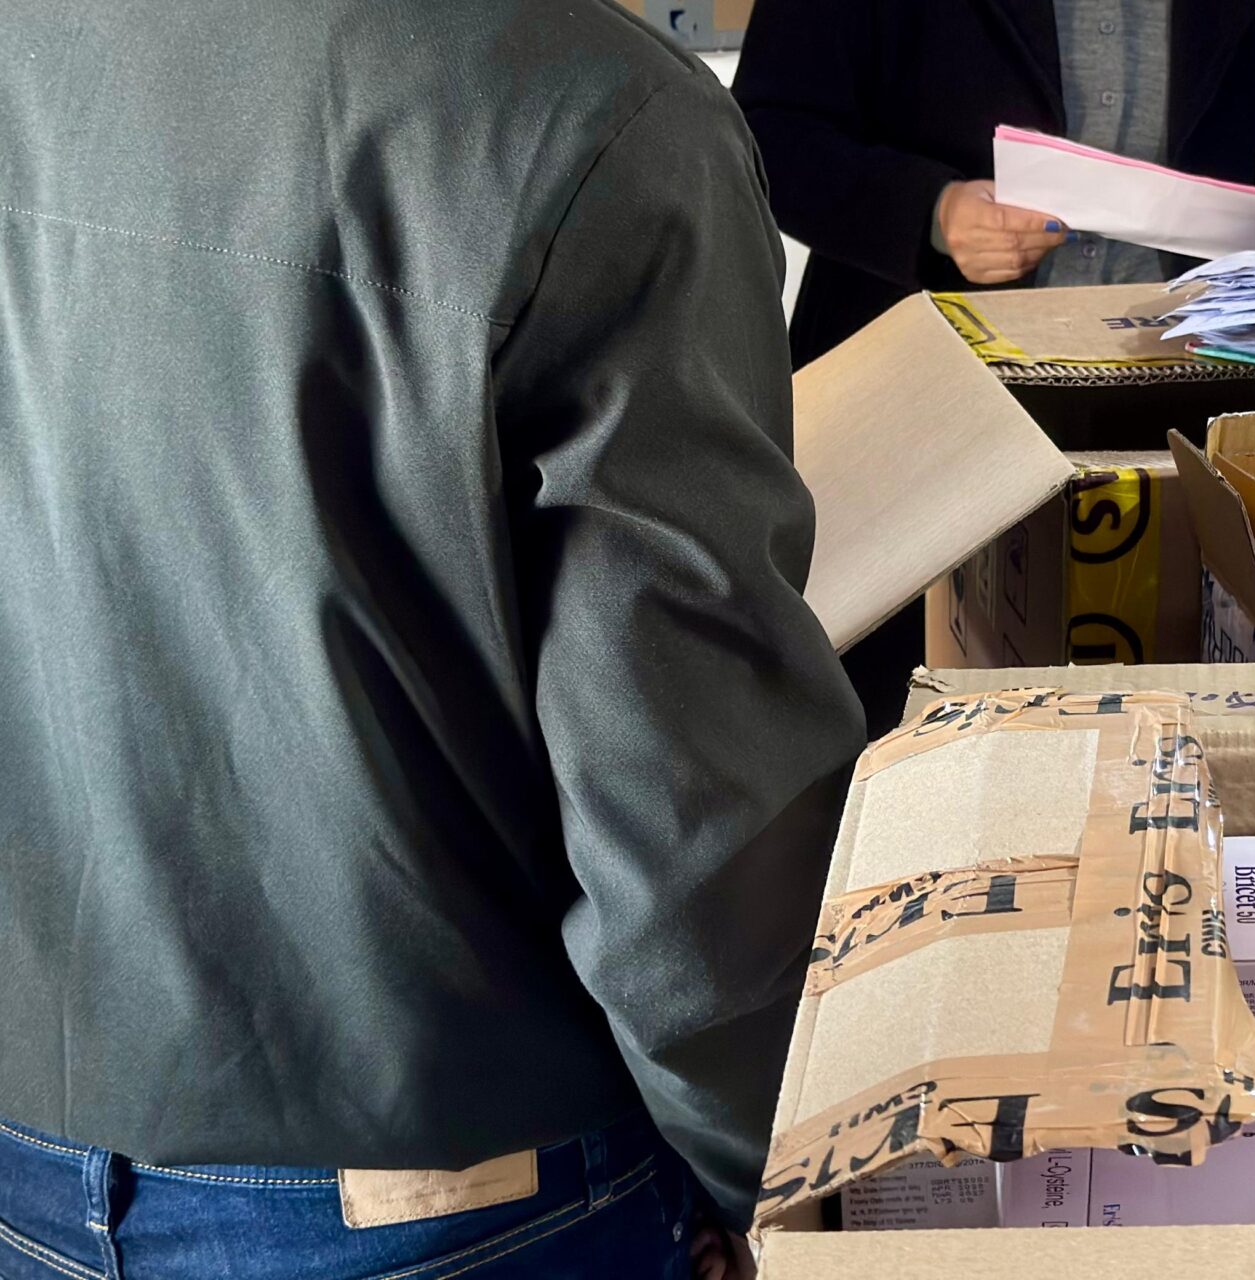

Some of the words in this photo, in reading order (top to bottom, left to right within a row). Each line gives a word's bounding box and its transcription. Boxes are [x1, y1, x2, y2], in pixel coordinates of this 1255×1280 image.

[1128, 734, 1204, 835] Eris
[1106, 870, 1193, 1007] Eris
[1042, 1156, 1072, 1209] L-Cysteine,
